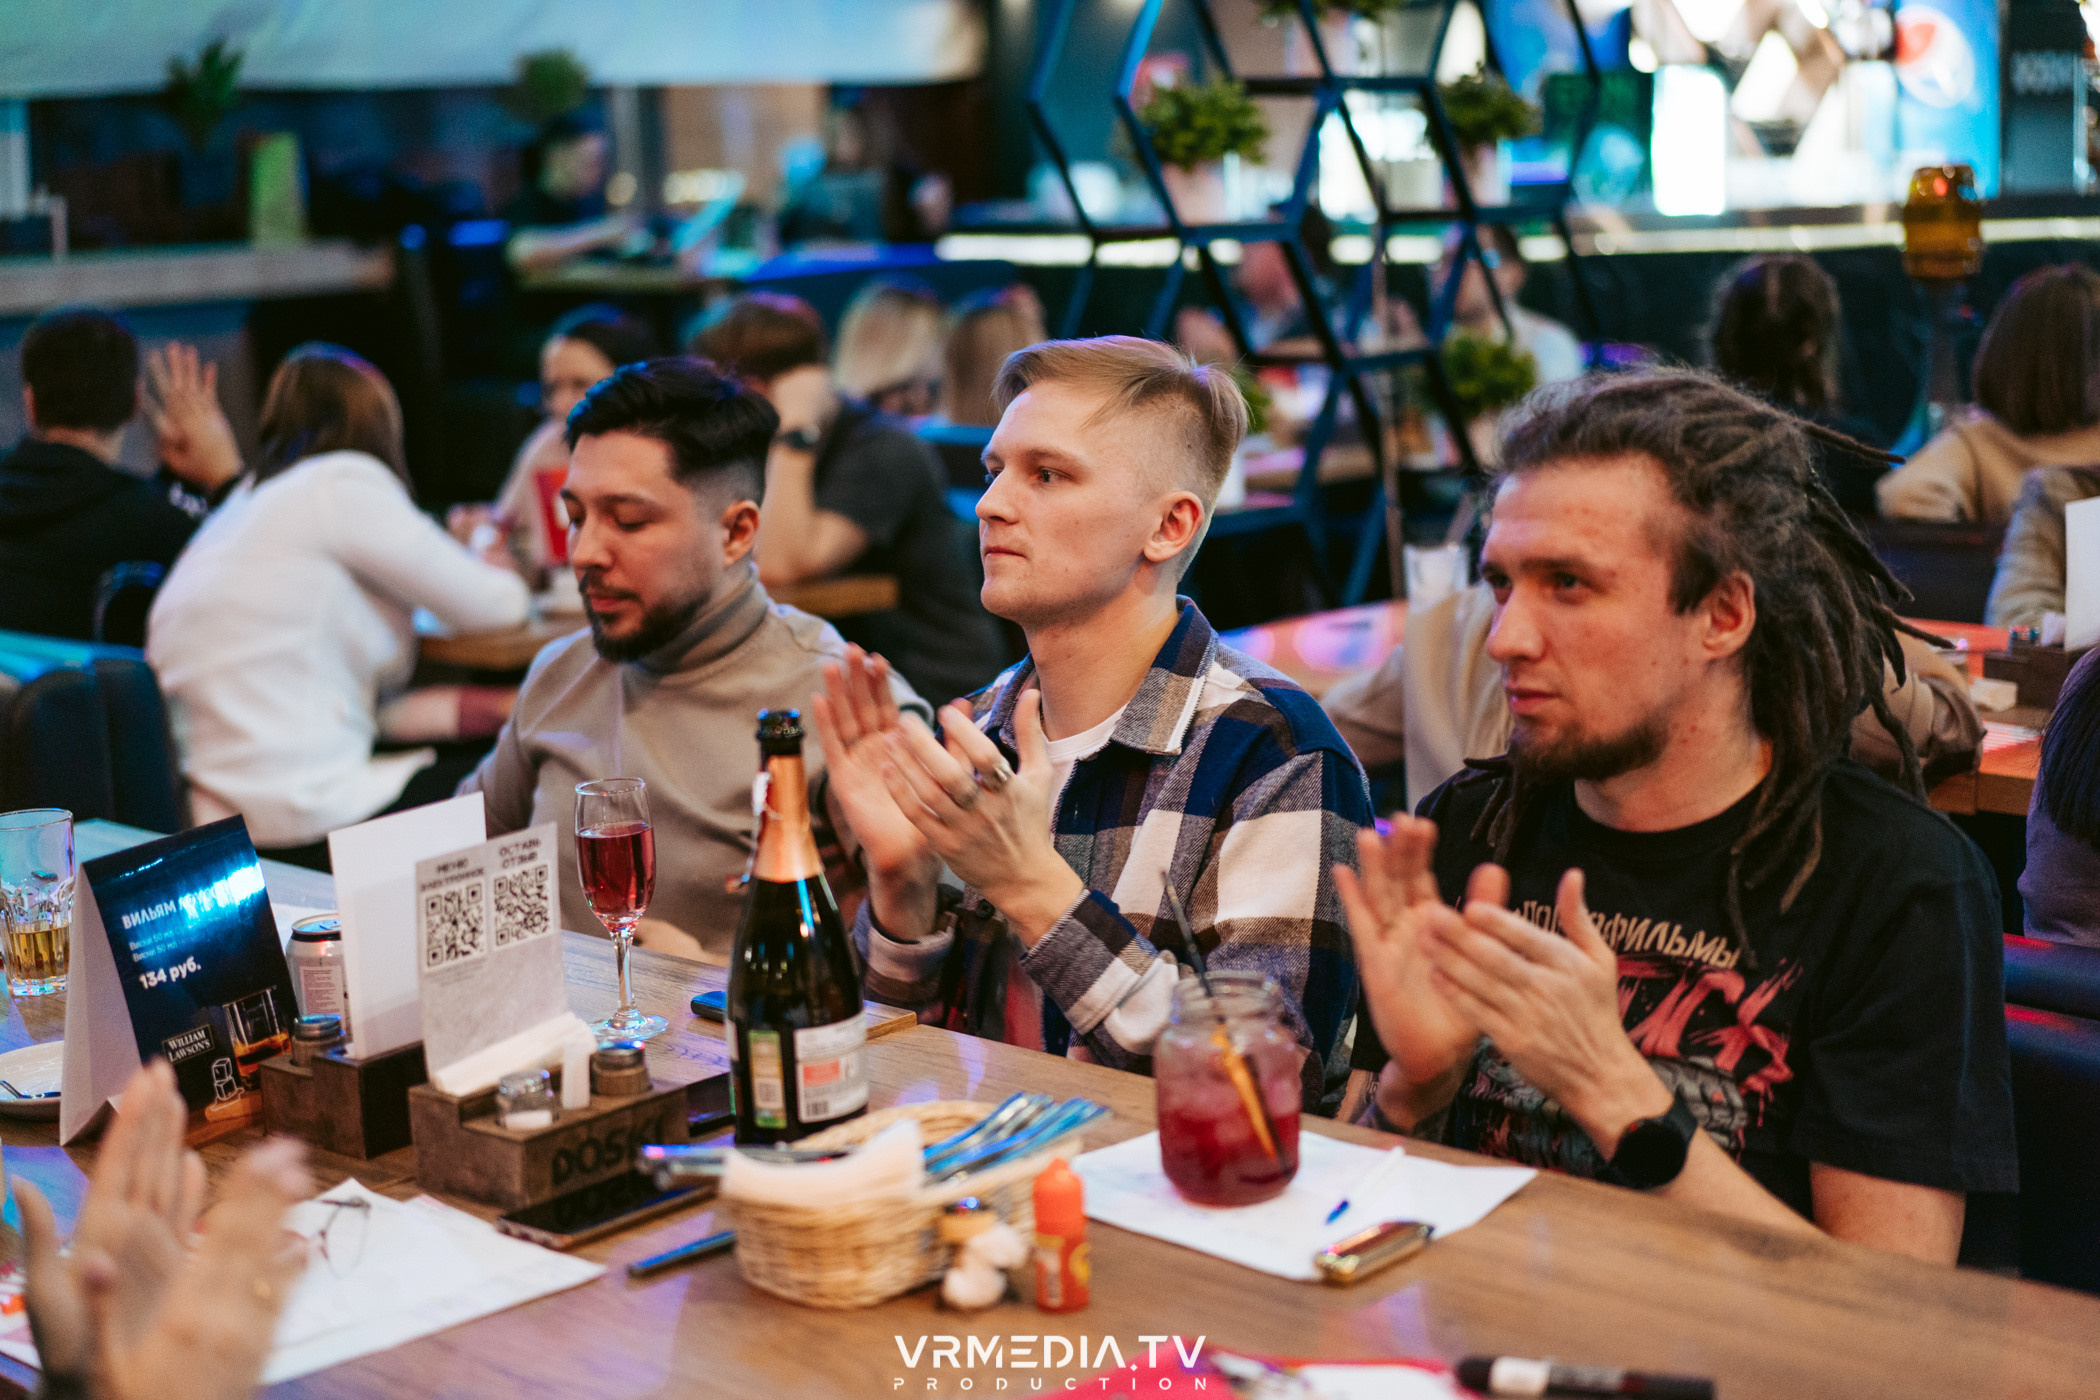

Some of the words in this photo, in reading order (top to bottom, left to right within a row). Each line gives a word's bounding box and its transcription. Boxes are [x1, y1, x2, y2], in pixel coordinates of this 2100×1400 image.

[121, 900, 177, 930] ВИЛЬЯМ
[139, 968, 167, 989] 134
[169, 956, 202, 982] руб.
[168, 1030, 206, 1050] WILLIAM
